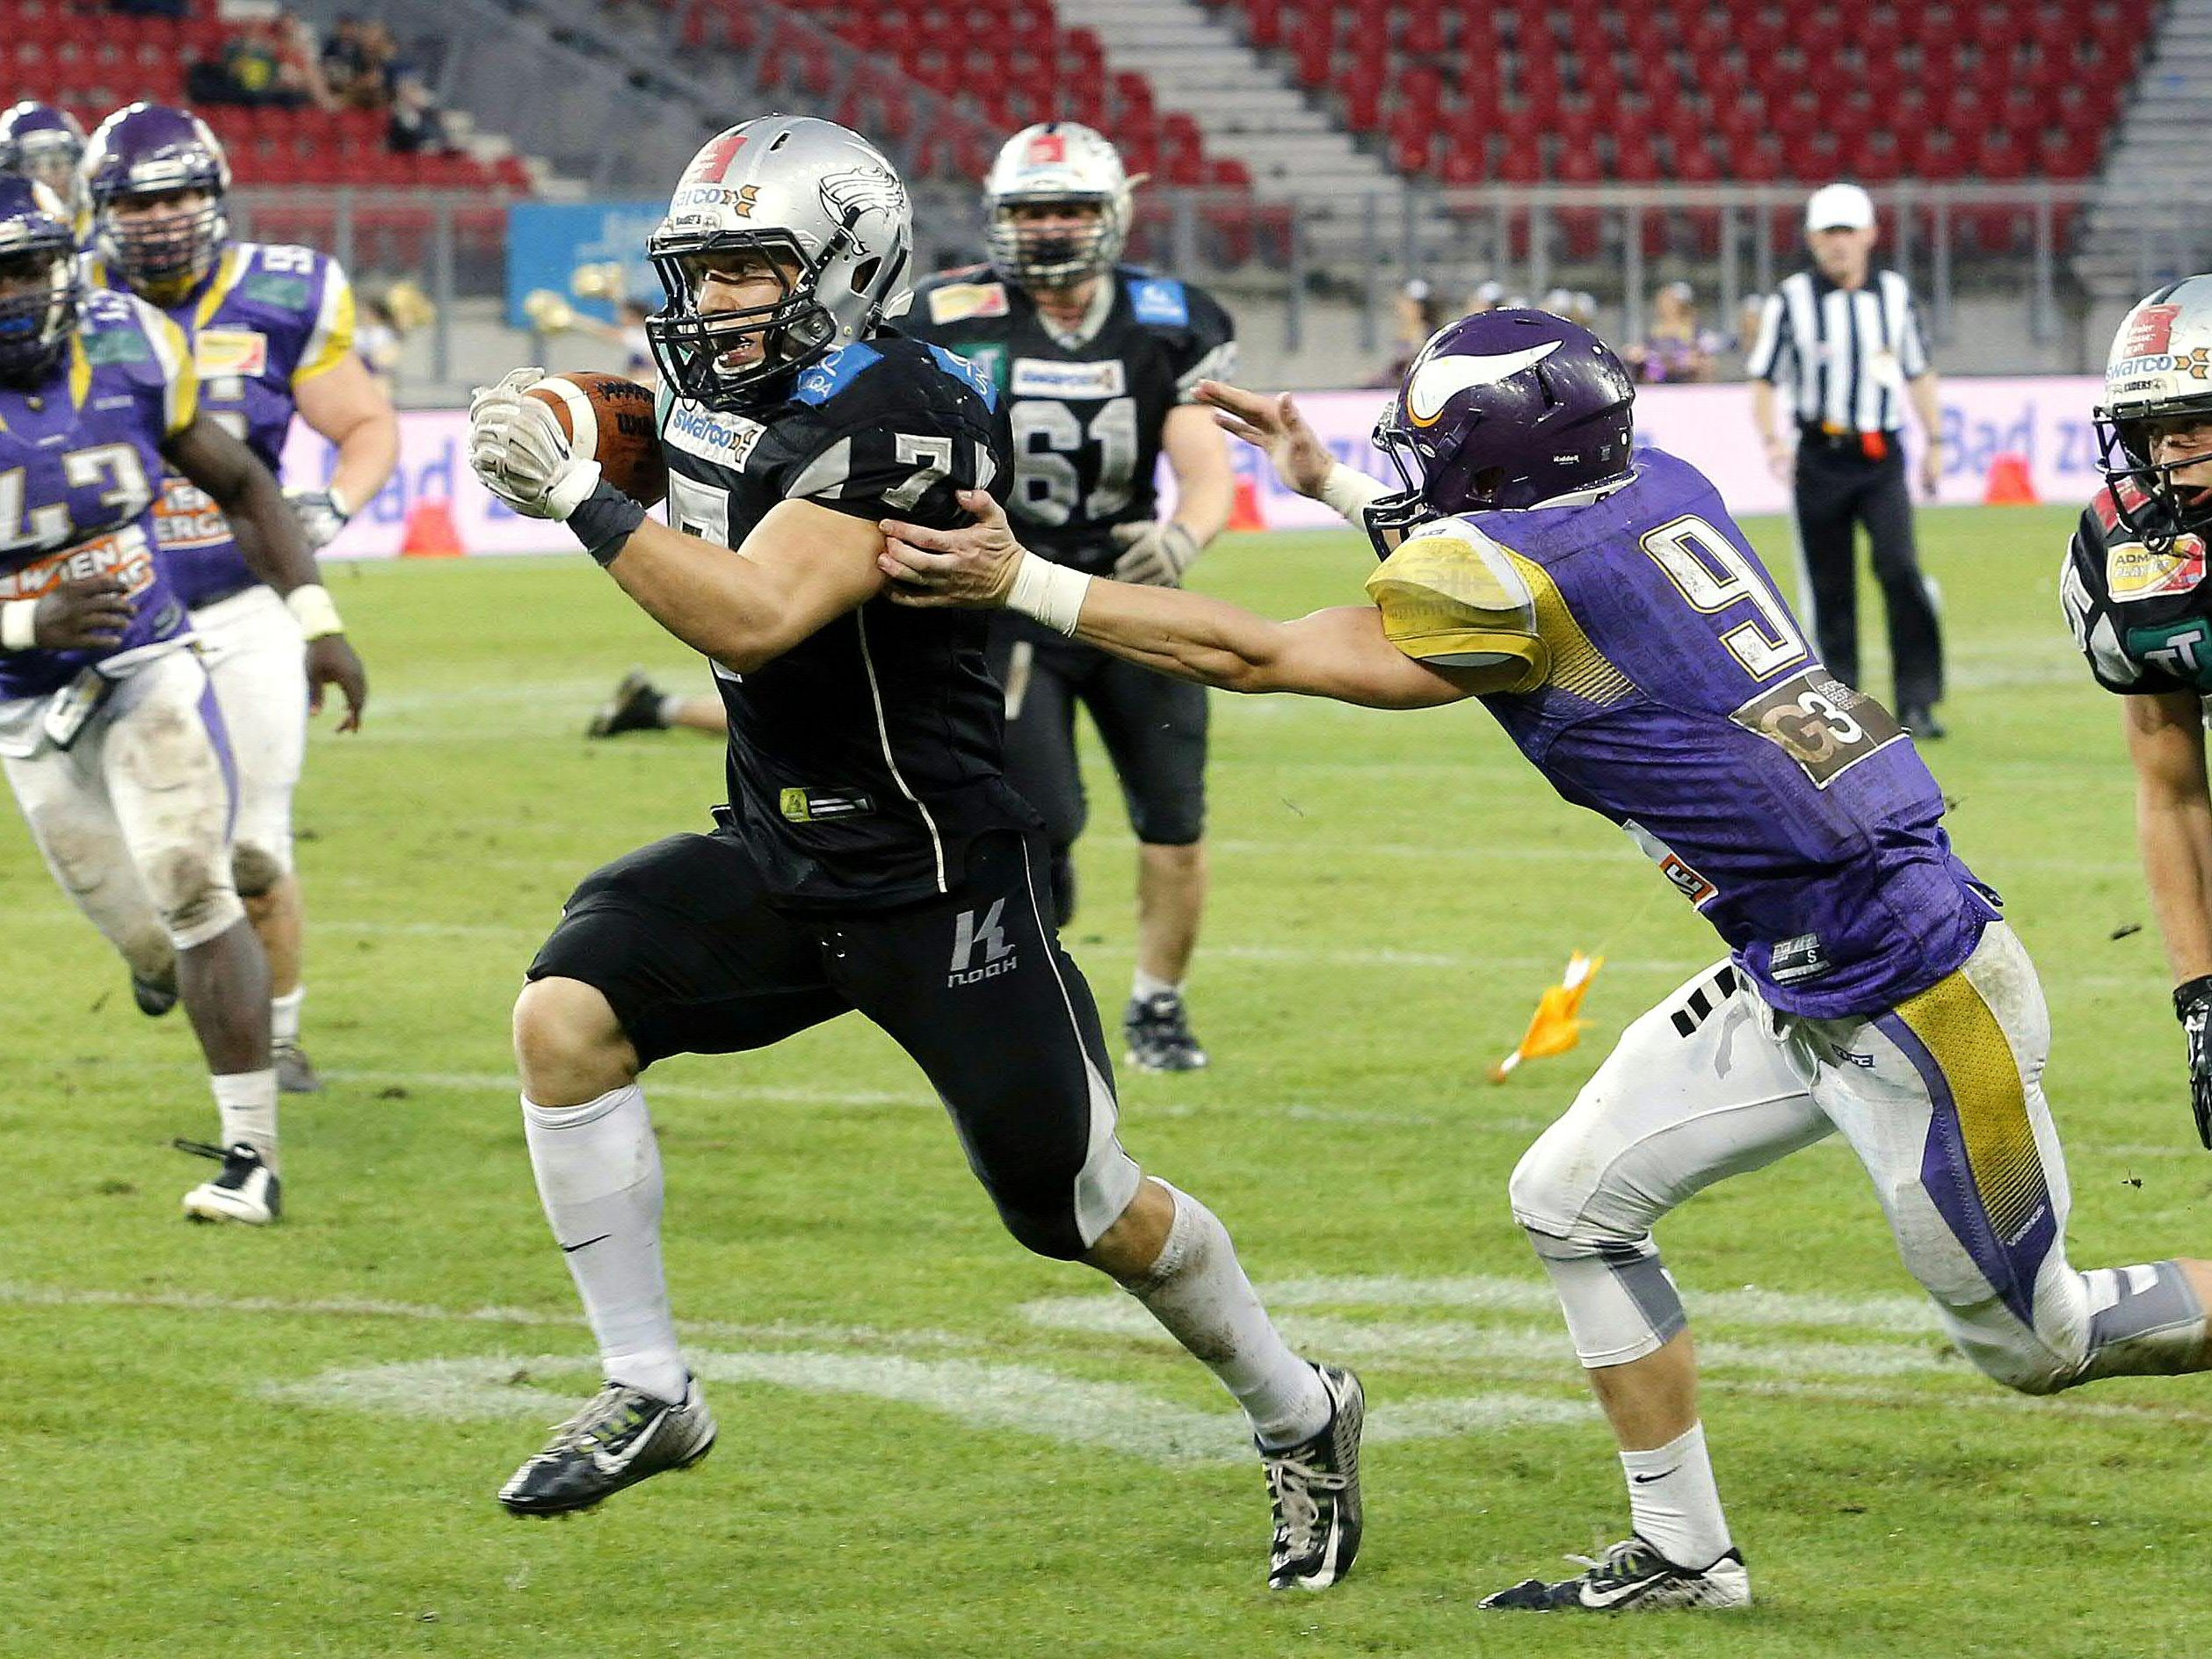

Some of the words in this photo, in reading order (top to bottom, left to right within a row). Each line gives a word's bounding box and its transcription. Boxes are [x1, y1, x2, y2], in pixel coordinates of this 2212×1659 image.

[880, 432, 953, 511] 7
[1006, 395, 1138, 525] 61
[1638, 512, 1809, 683] 9
